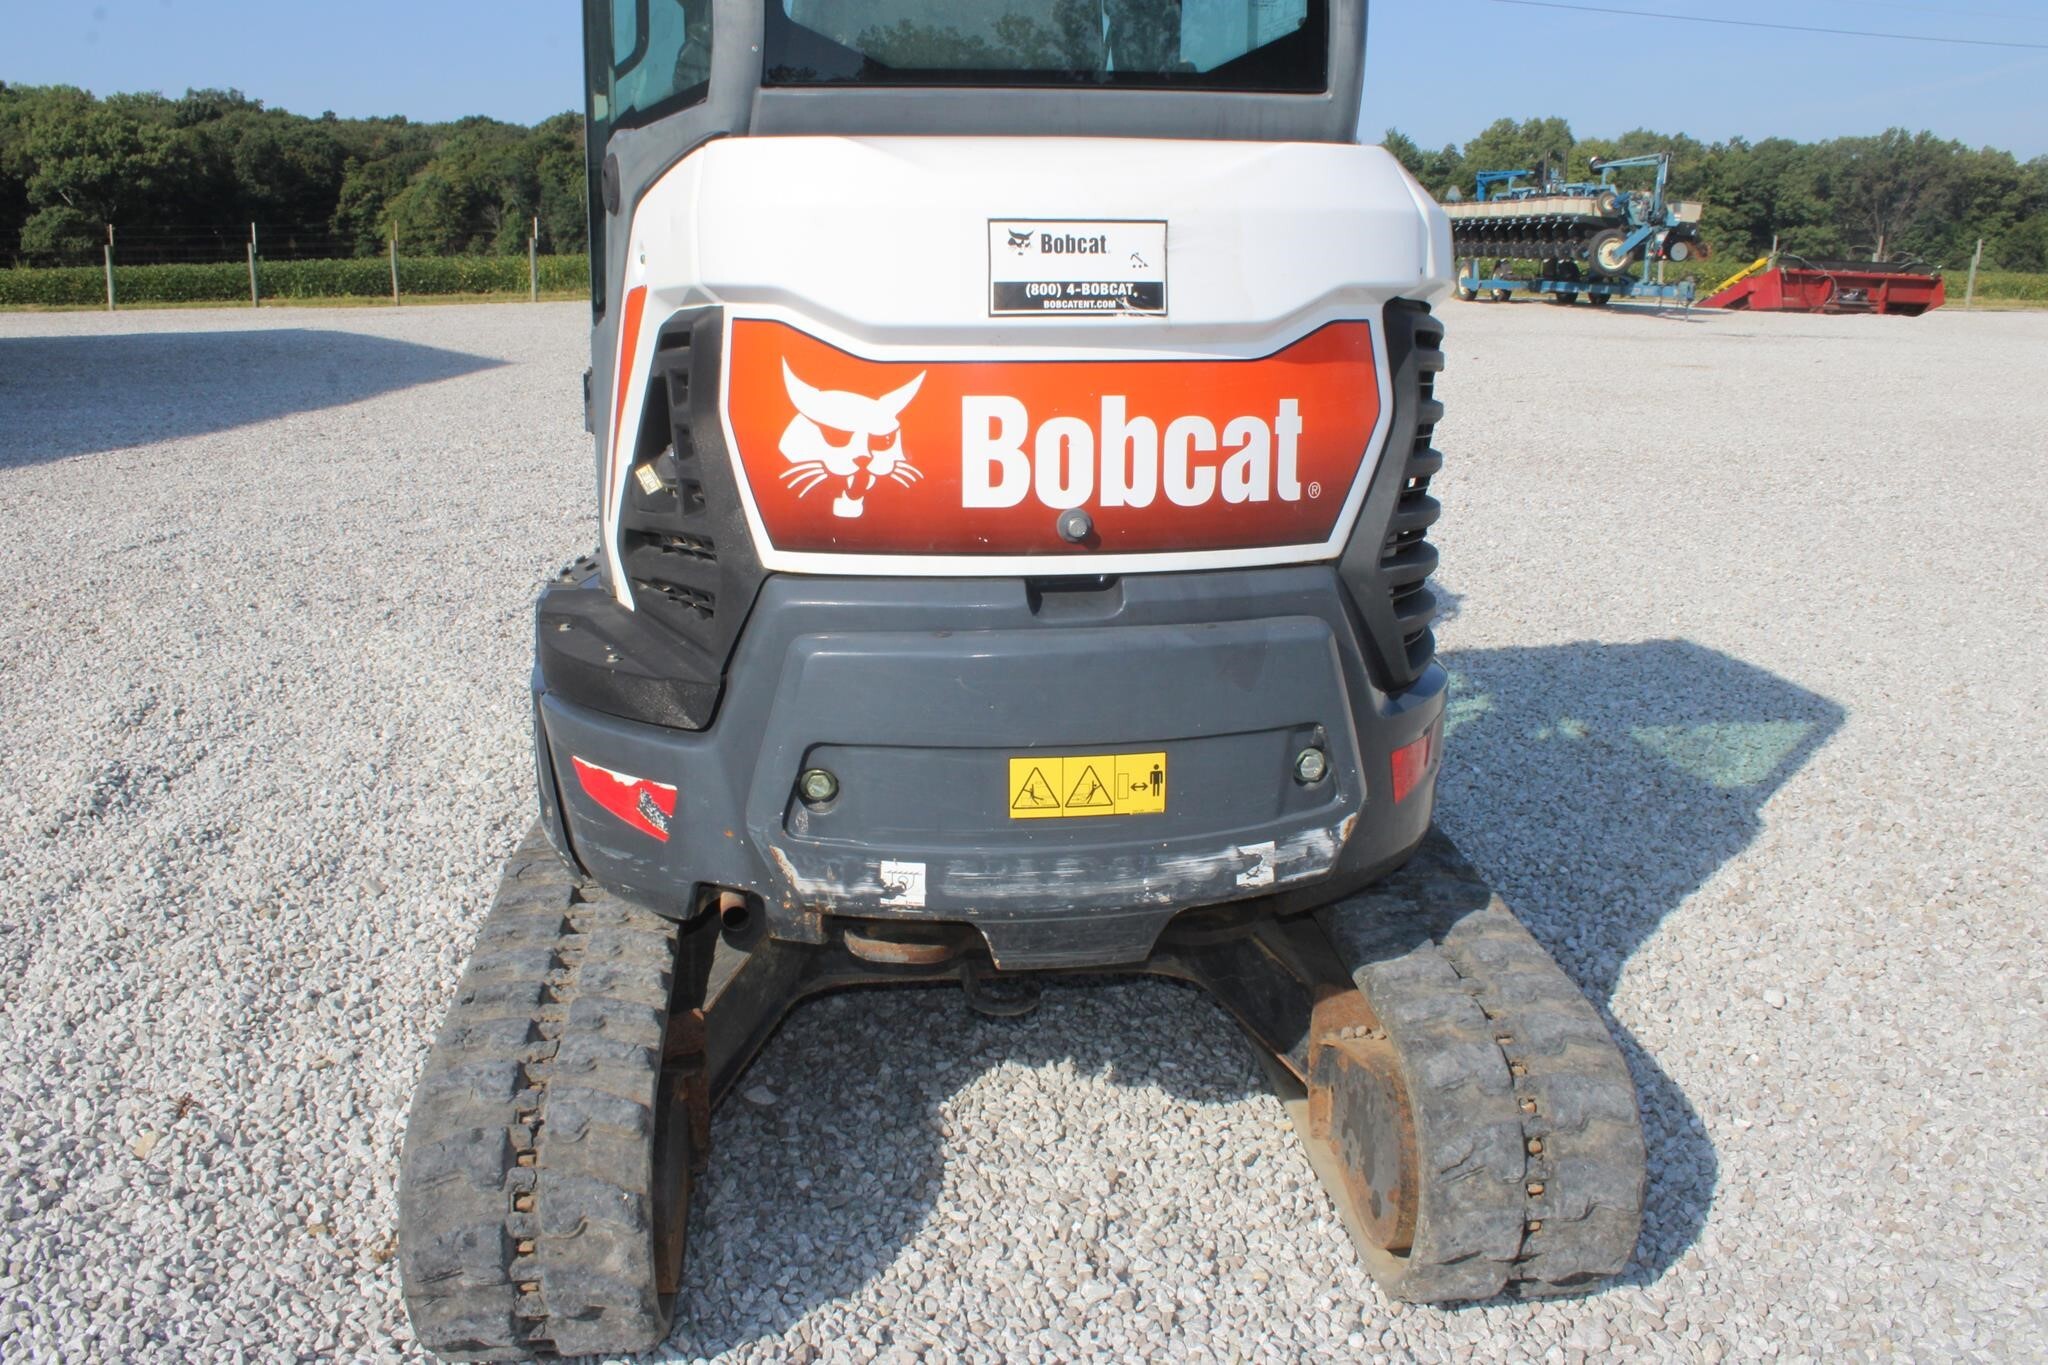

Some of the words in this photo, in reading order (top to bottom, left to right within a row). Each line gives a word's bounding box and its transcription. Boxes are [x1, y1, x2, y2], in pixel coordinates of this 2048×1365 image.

[1040, 233, 1107, 254] Bobcat
[1025, 282, 1062, 298] (800)
[1066, 282, 1134, 296] 4-BOBCAT
[1043, 300, 1117, 309] BOBCATENT.COM
[961, 394, 1303, 510] Bobcat
